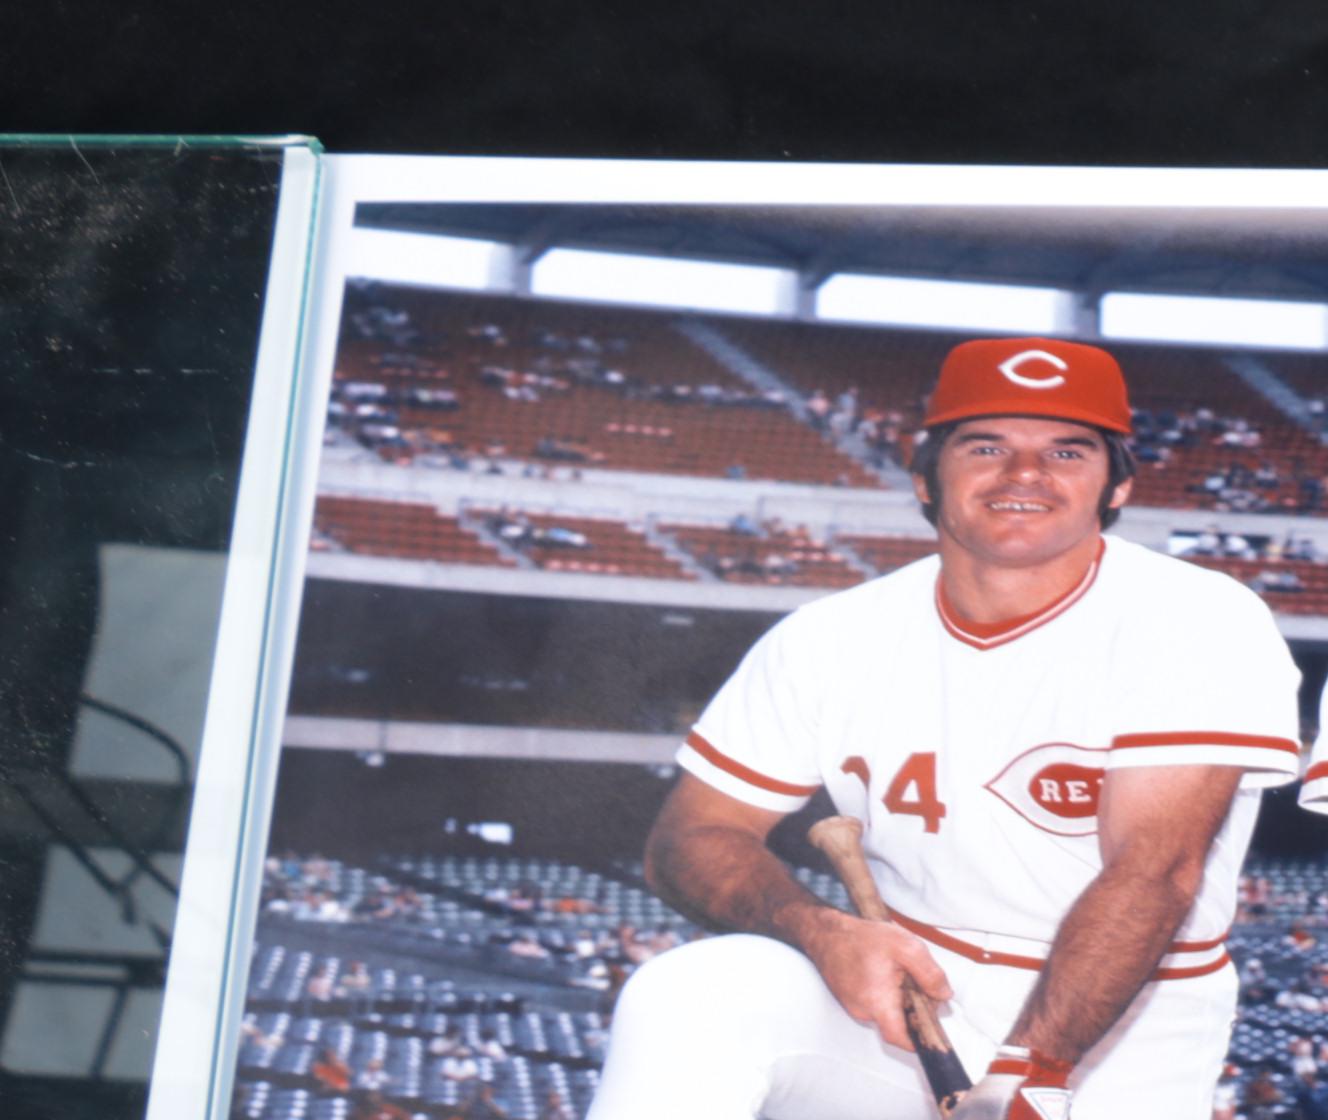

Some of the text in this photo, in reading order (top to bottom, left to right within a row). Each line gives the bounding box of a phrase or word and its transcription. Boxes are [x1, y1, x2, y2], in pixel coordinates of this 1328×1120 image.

[998, 350, 1068, 389] C
[840, 751, 947, 835] 4
[1039, 778, 1104, 803] RE
